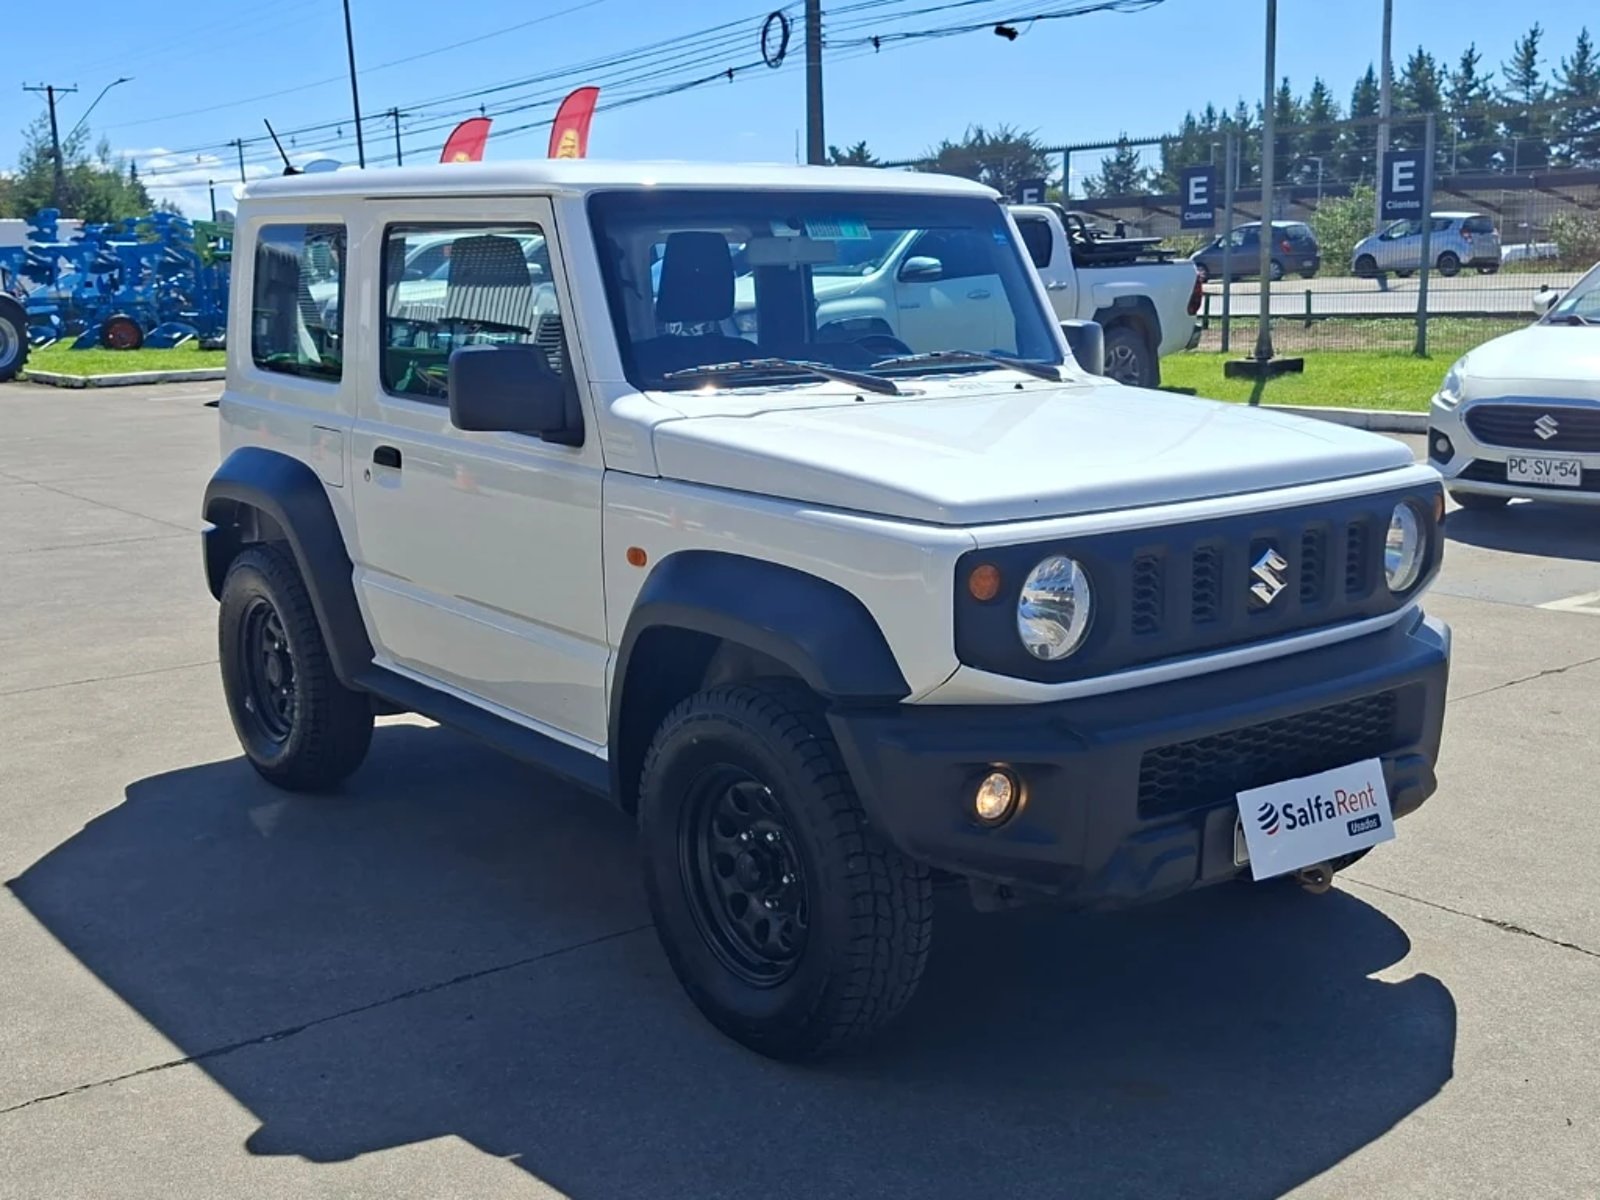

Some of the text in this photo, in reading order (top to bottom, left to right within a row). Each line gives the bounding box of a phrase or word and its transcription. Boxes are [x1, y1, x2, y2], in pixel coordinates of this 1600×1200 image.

[1188, 176, 1208, 205] E
[1392, 160, 1415, 192] E
[1282, 781, 1377, 831] SalfaRent
